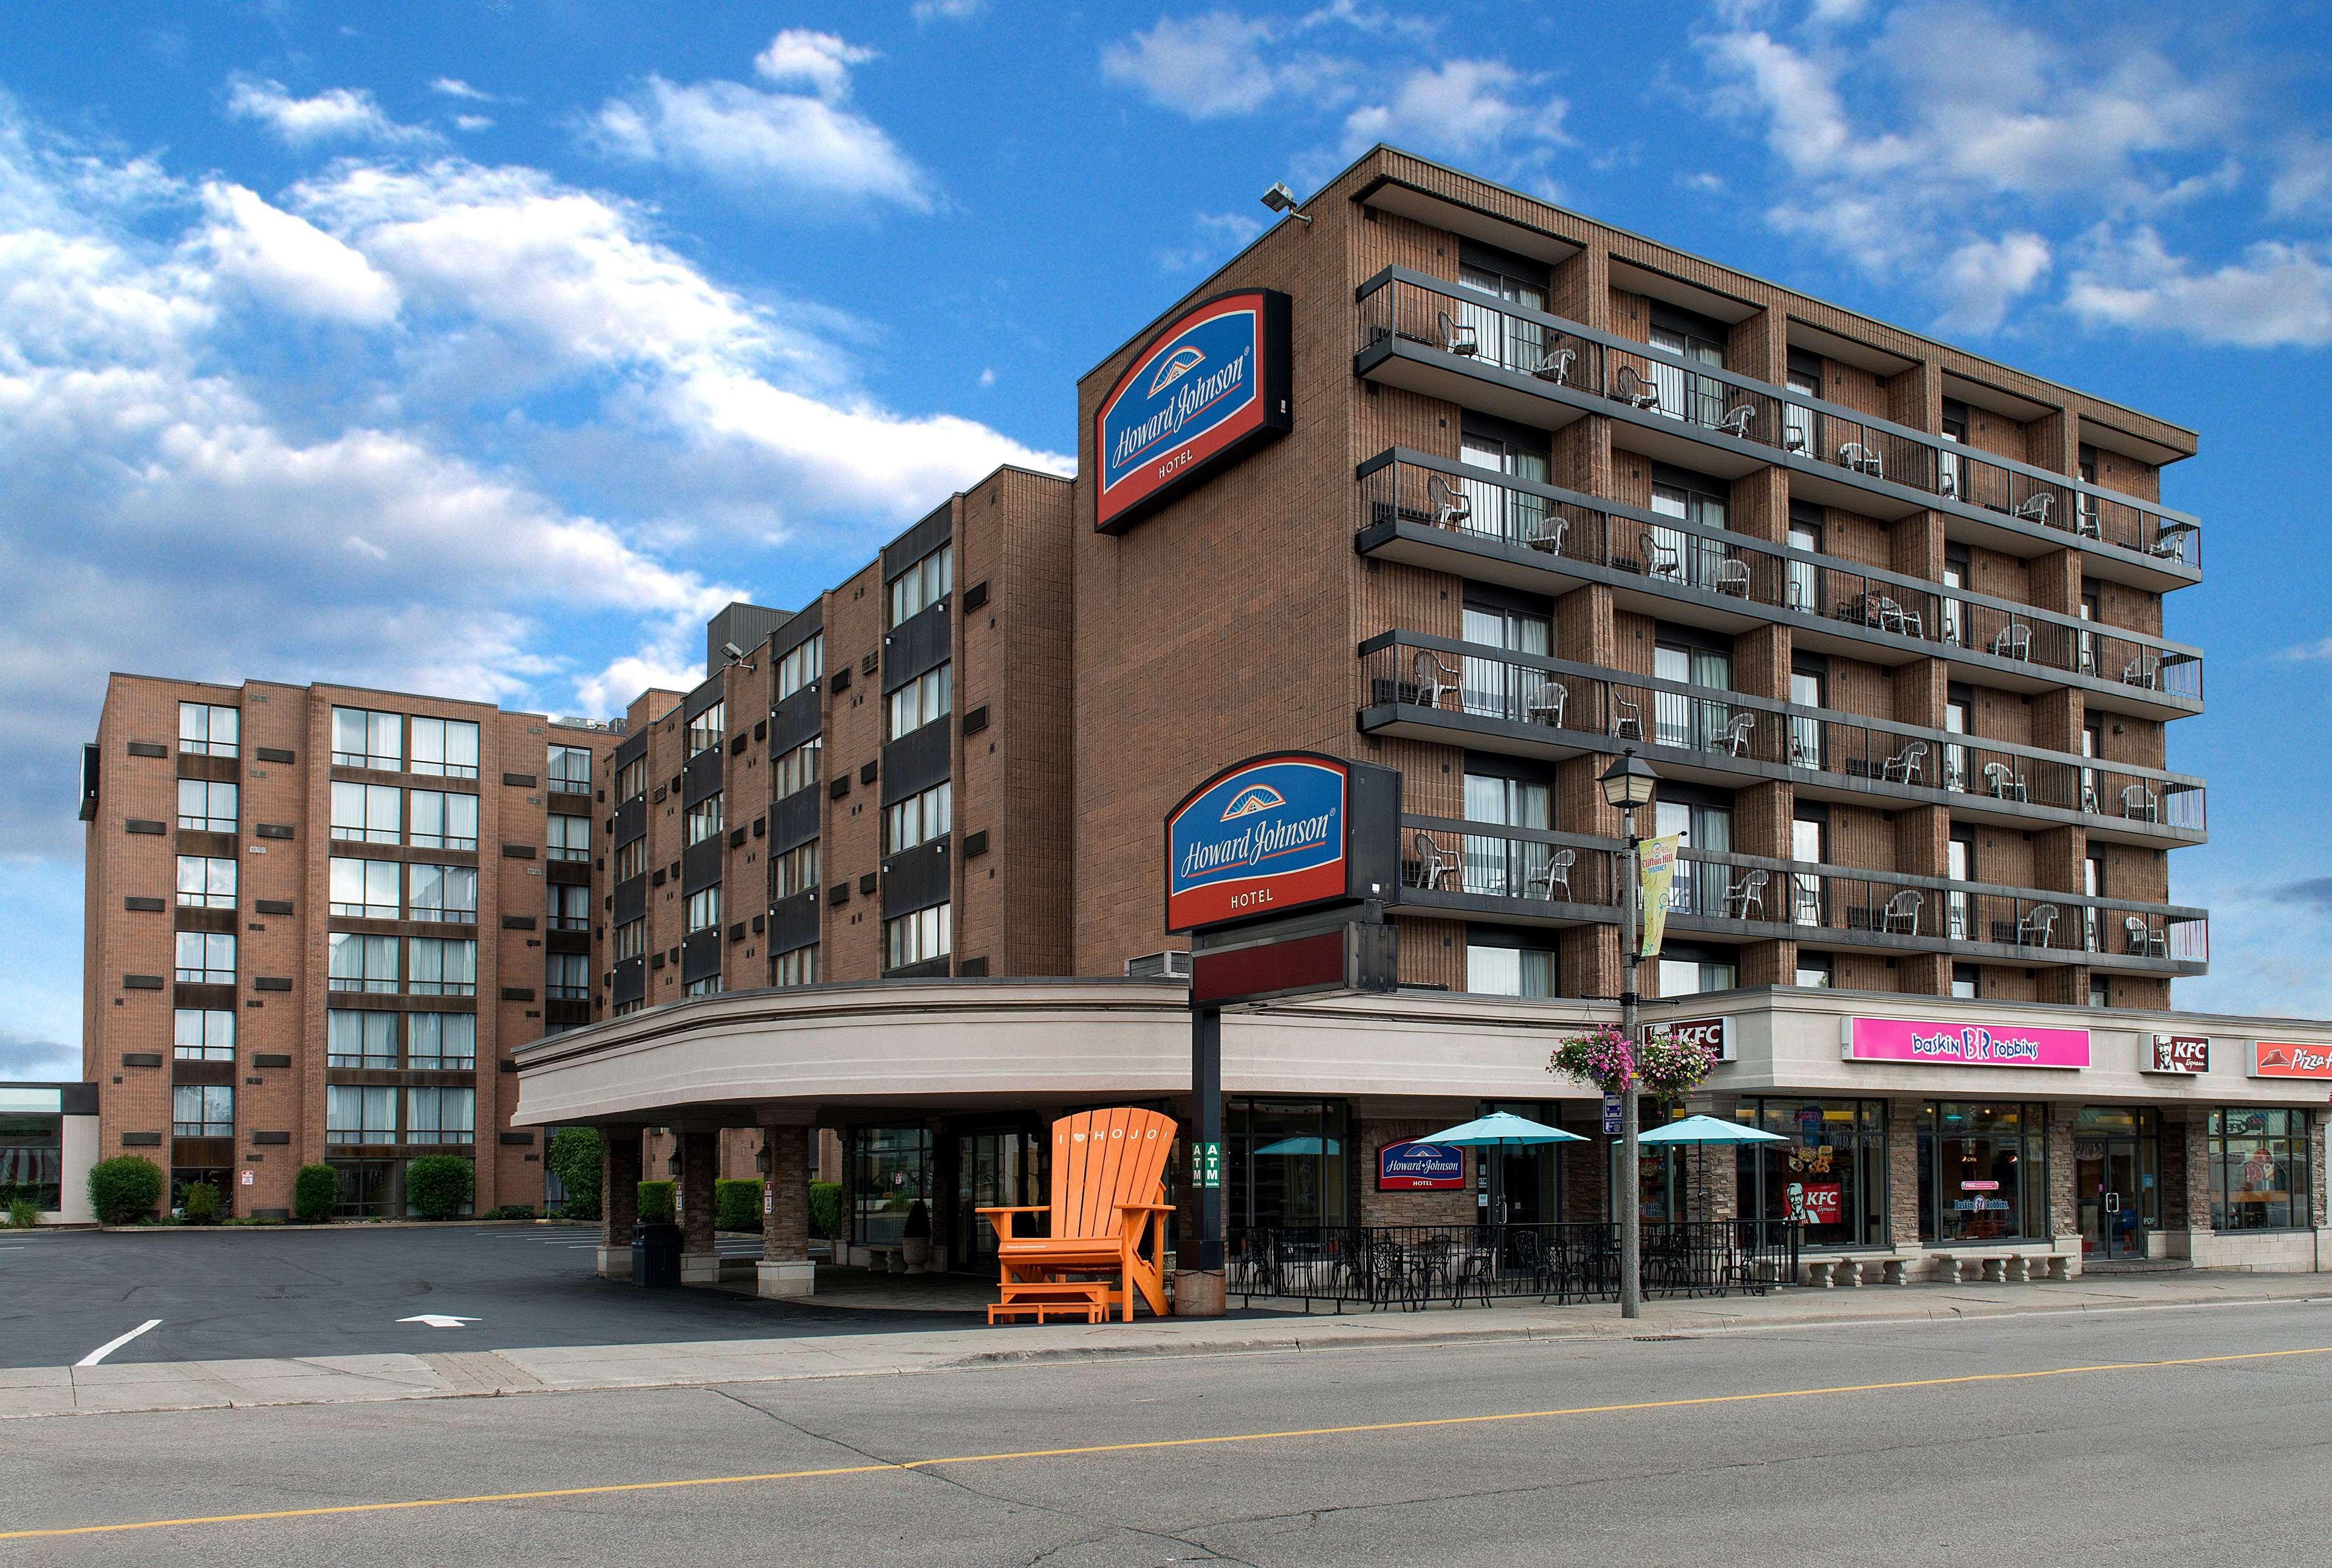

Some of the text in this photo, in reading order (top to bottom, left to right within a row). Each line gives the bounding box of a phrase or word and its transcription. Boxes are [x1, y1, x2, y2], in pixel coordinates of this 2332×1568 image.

[1112, 355, 1244, 469] Howard Johnson
[1158, 448, 1193, 479] HOTEL
[1181, 813, 1327, 878] Howard Johnson
[1642, 853, 1673, 868] Clifton Hill
[1648, 864, 1666, 874] DISTRICT
[1230, 888, 1273, 909] HOTEL
[1678, 1025, 1720, 1045] KFC
[1912, 1027, 2038, 1060] baskin BR robbins
[2173, 1041, 2207, 1059] KFC
[2185, 1058, 2205, 1069] Express
[2291, 1048, 2325, 1071] Pizza
[1797, 1111, 1821, 1122] OPEN
[1059, 1134, 1063, 1144] I
[1206, 1144, 1218, 1180] ATM
[1386, 1159, 1458, 1174] Howard Johnson
[1805, 1191, 1838, 1205] KFC
[1954, 1199, 1974, 1210] Baskin
[1985, 1199, 2008, 1210] Robbins
[1817, 1205, 1837, 1215] Express
